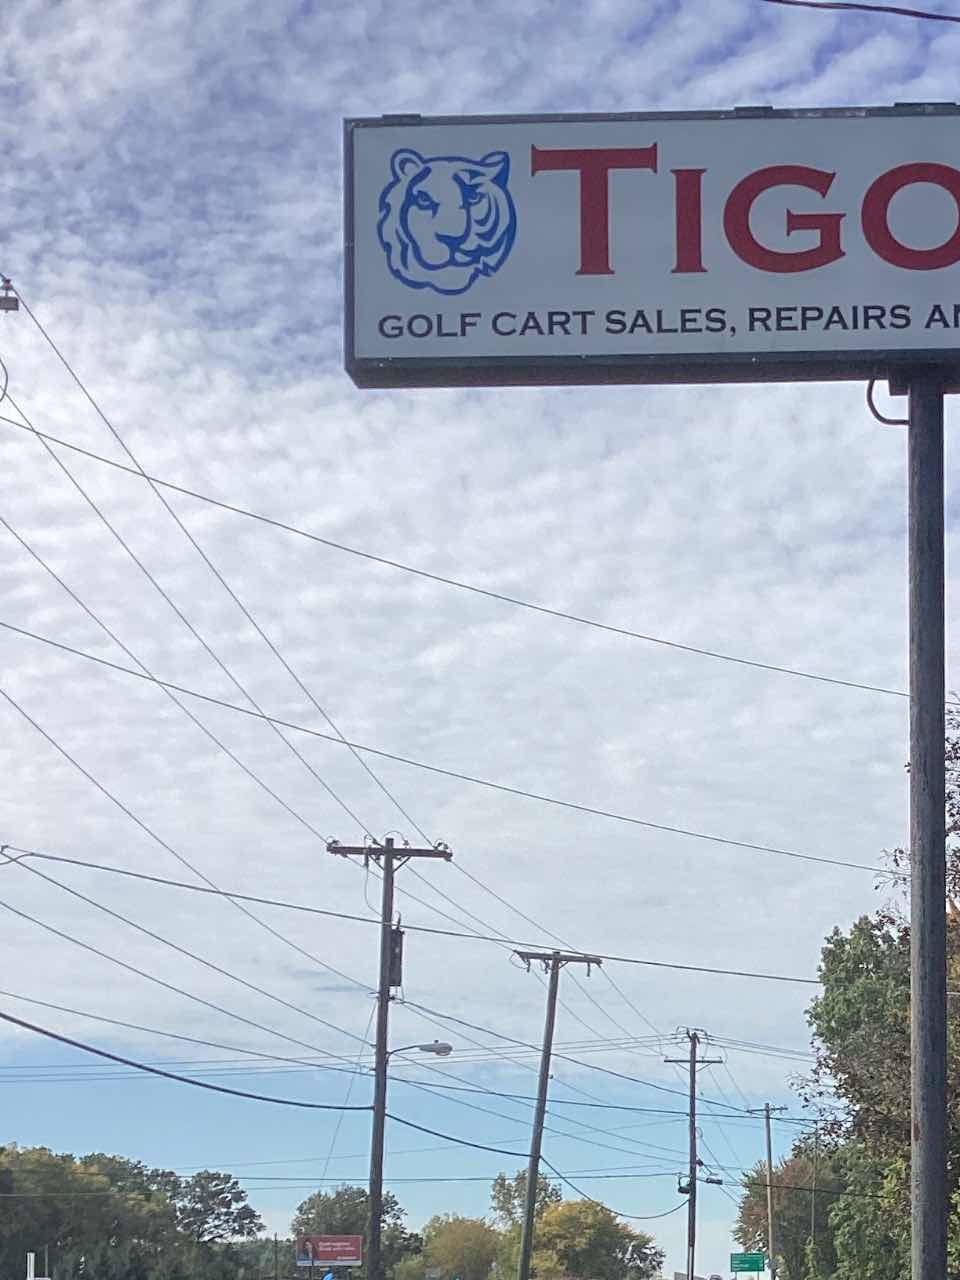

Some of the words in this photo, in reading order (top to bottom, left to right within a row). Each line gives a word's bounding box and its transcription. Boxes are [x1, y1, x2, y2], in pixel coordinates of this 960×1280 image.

[377, 312, 481, 339] GOLF
[491, 310, 596, 337] CART
[604, 308, 737, 337] SALES,
[748, 304, 912, 333] REPAIRS
